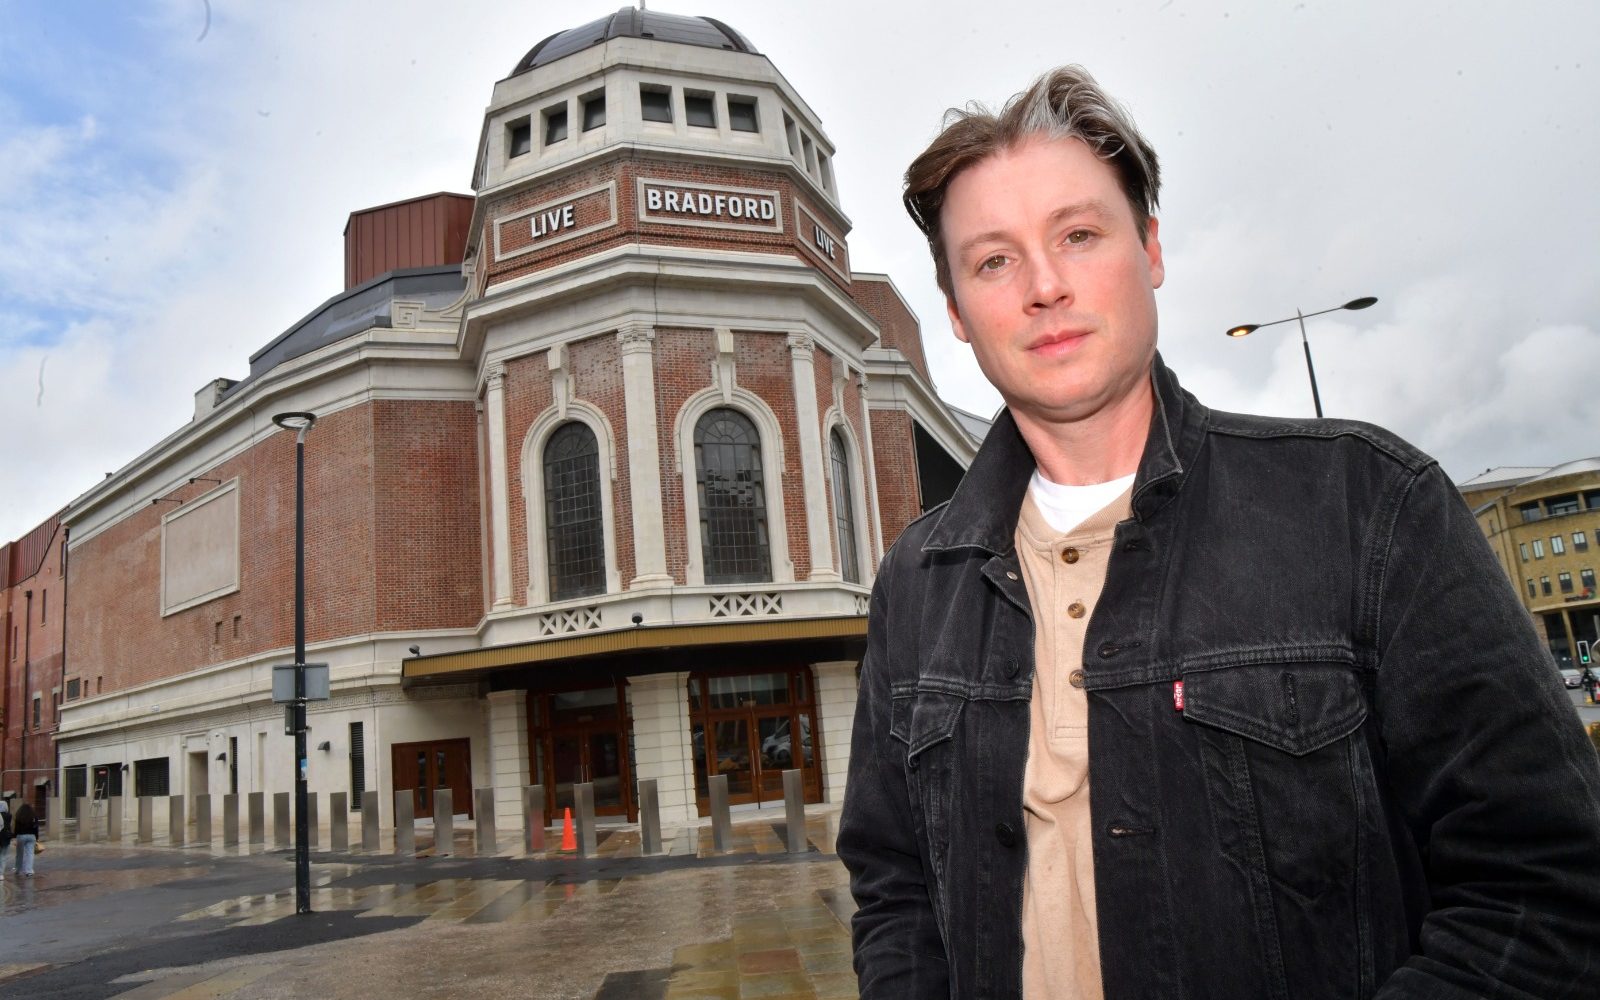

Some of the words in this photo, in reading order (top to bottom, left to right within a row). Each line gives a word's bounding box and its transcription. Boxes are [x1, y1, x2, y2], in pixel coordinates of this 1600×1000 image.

[531, 204, 575, 238] LIVE
[647, 188, 775, 220] BRADFORD
[814, 225, 836, 260] LIVE
